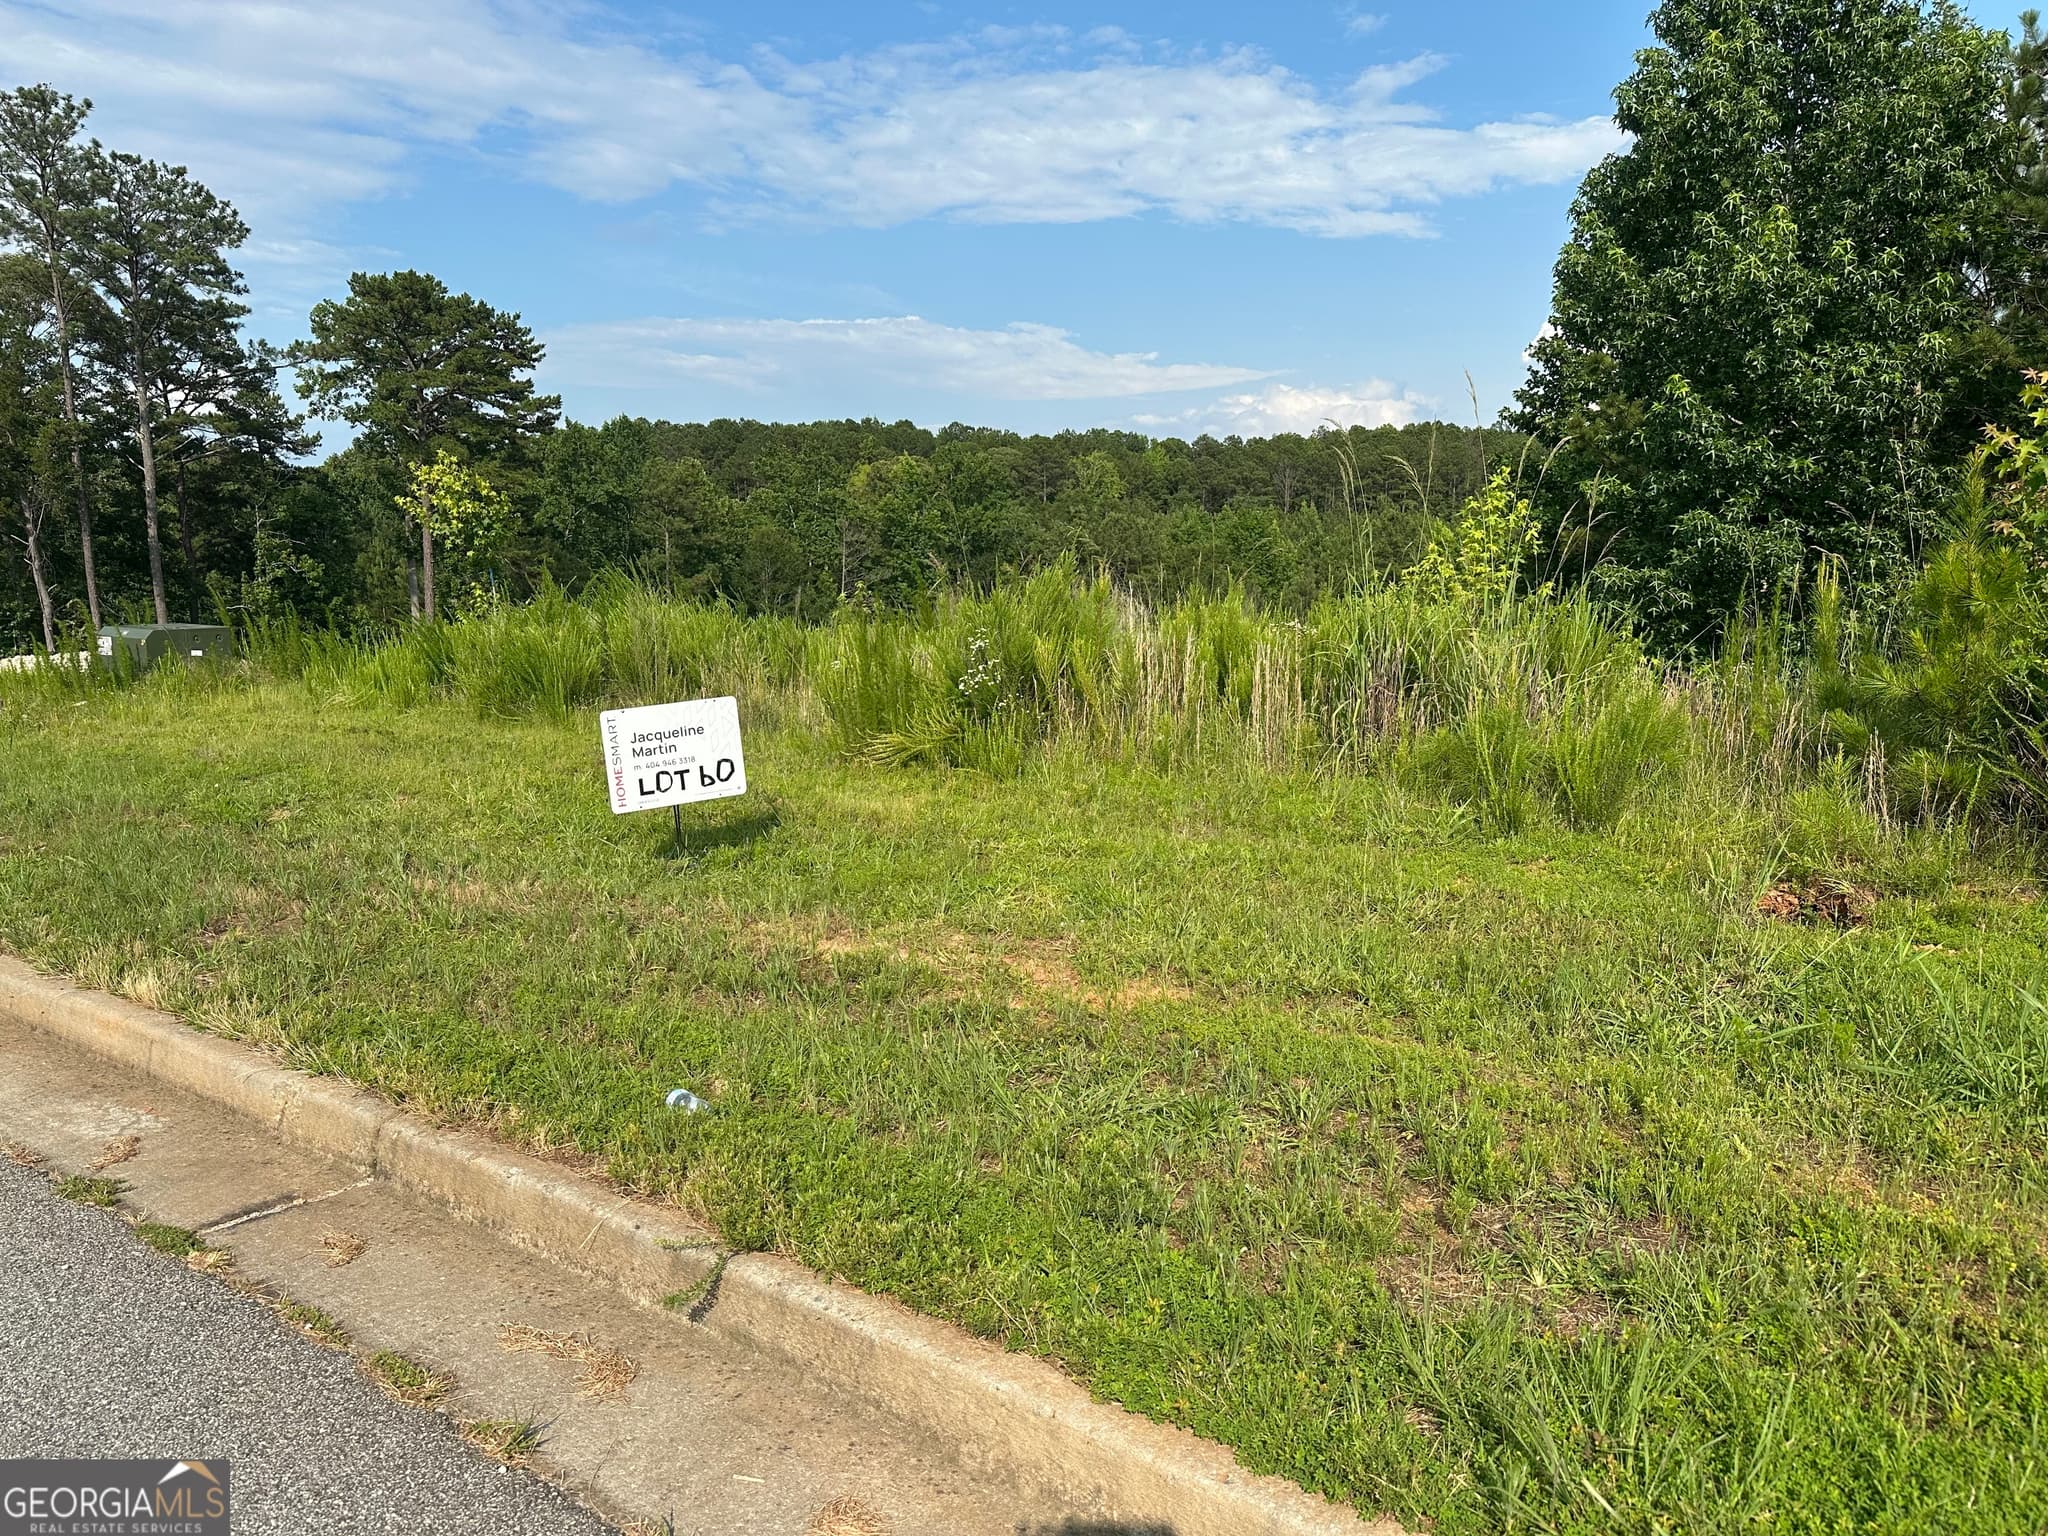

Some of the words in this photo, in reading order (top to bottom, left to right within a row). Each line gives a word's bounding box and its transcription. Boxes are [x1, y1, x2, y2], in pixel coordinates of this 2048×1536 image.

[630, 726, 705, 744] Jacqueline
[632, 743, 677, 758] Martin
[606, 717, 627, 807] HOMESMART
[645, 761, 660, 769] 404
[663, 758, 677, 767] 946
[679, 756, 696, 764] 3318
[638, 769, 690, 796] LOT
